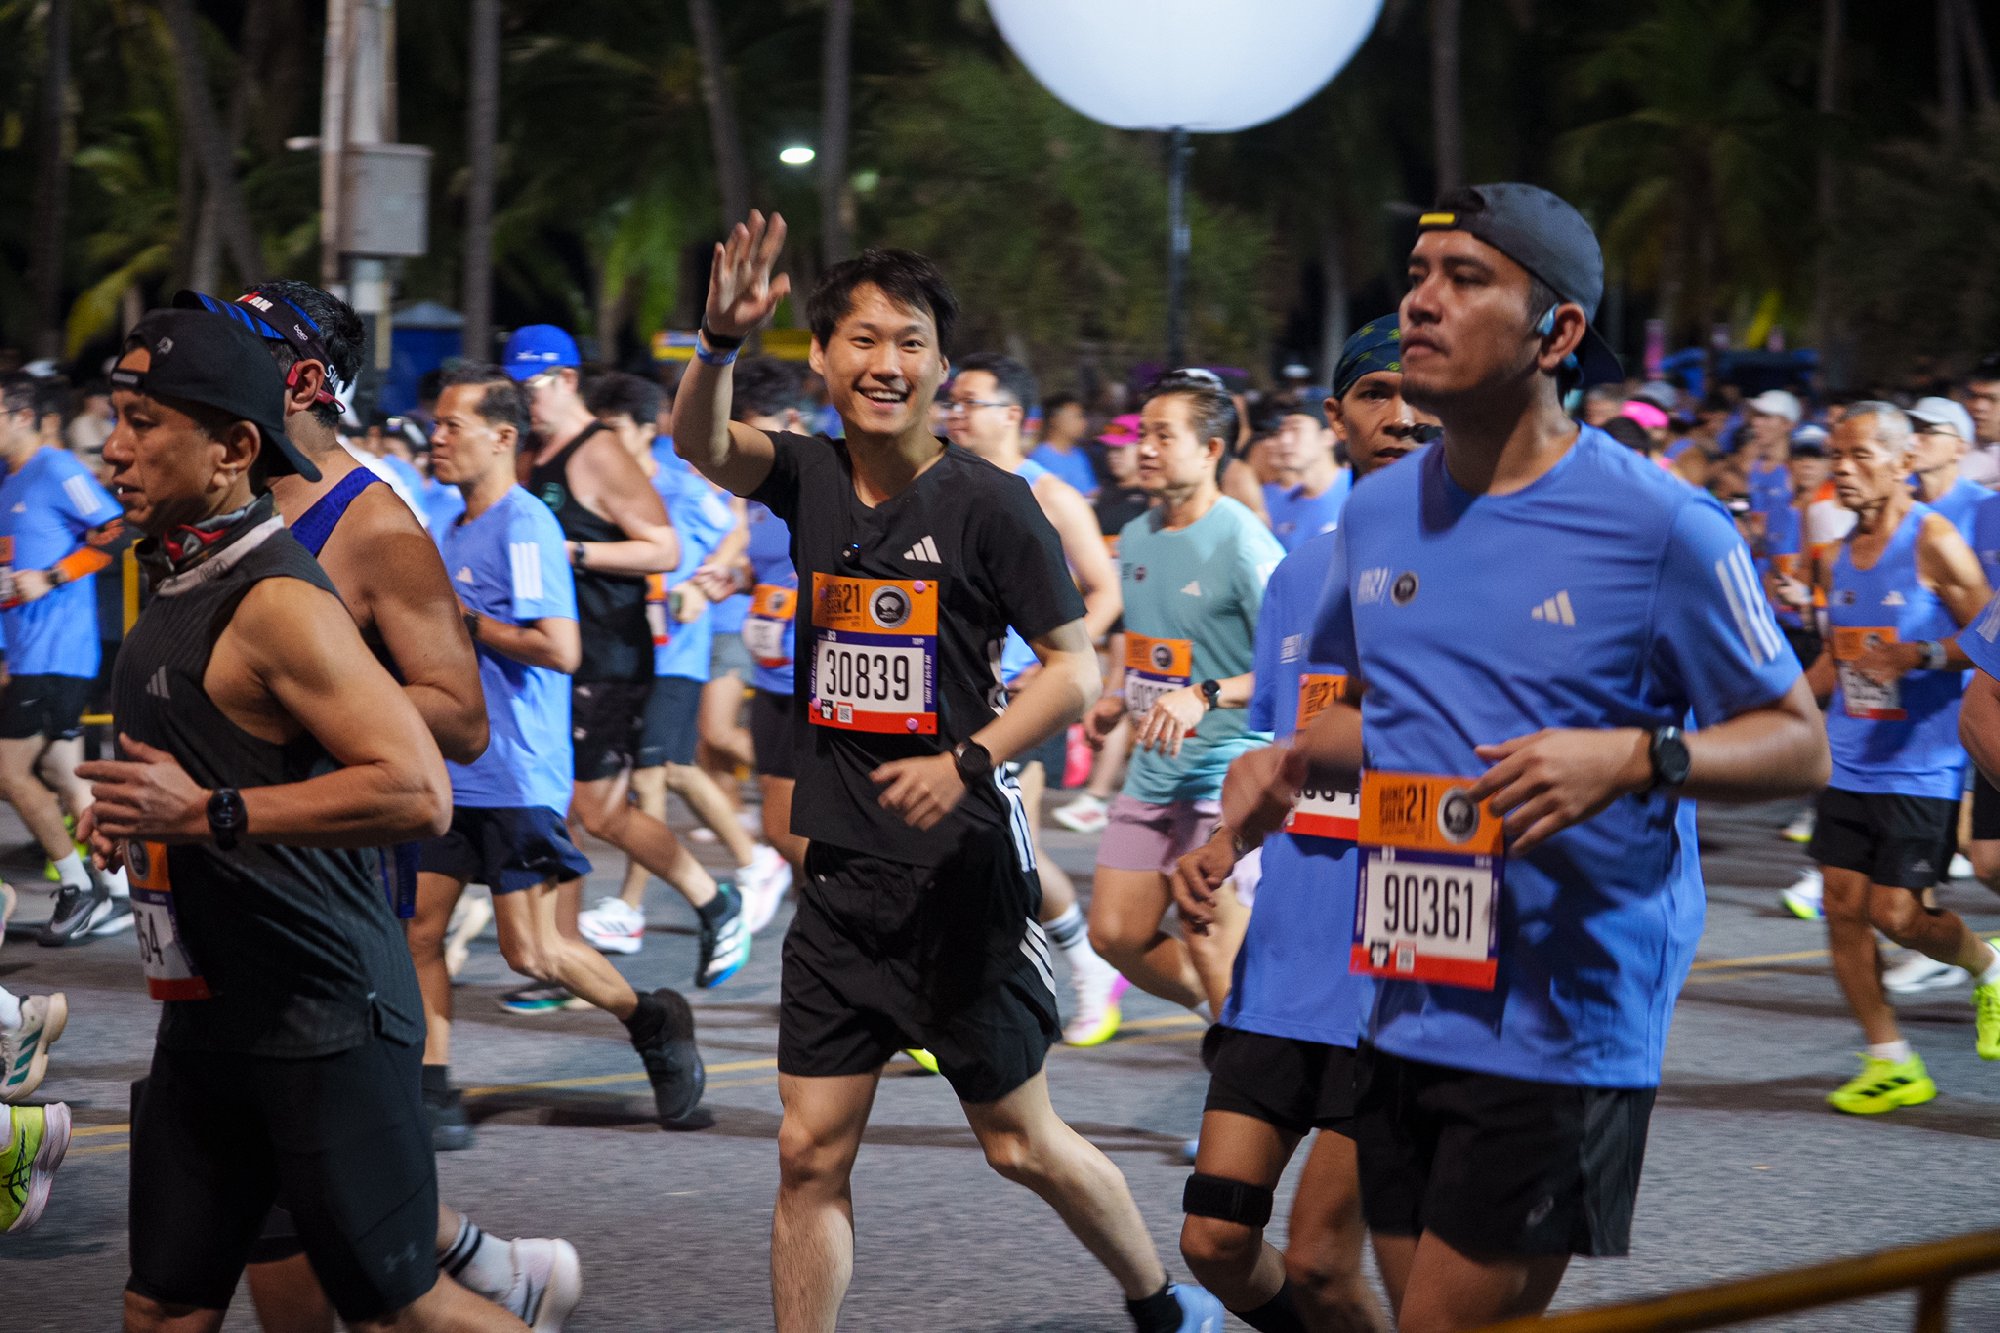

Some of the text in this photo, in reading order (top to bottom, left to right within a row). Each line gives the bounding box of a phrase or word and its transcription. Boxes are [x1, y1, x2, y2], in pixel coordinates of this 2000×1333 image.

[843, 583, 860, 613] 21
[826, 649, 909, 701] 30839
[1406, 784, 1427, 823] 21
[1384, 873, 1474, 942] 90361
